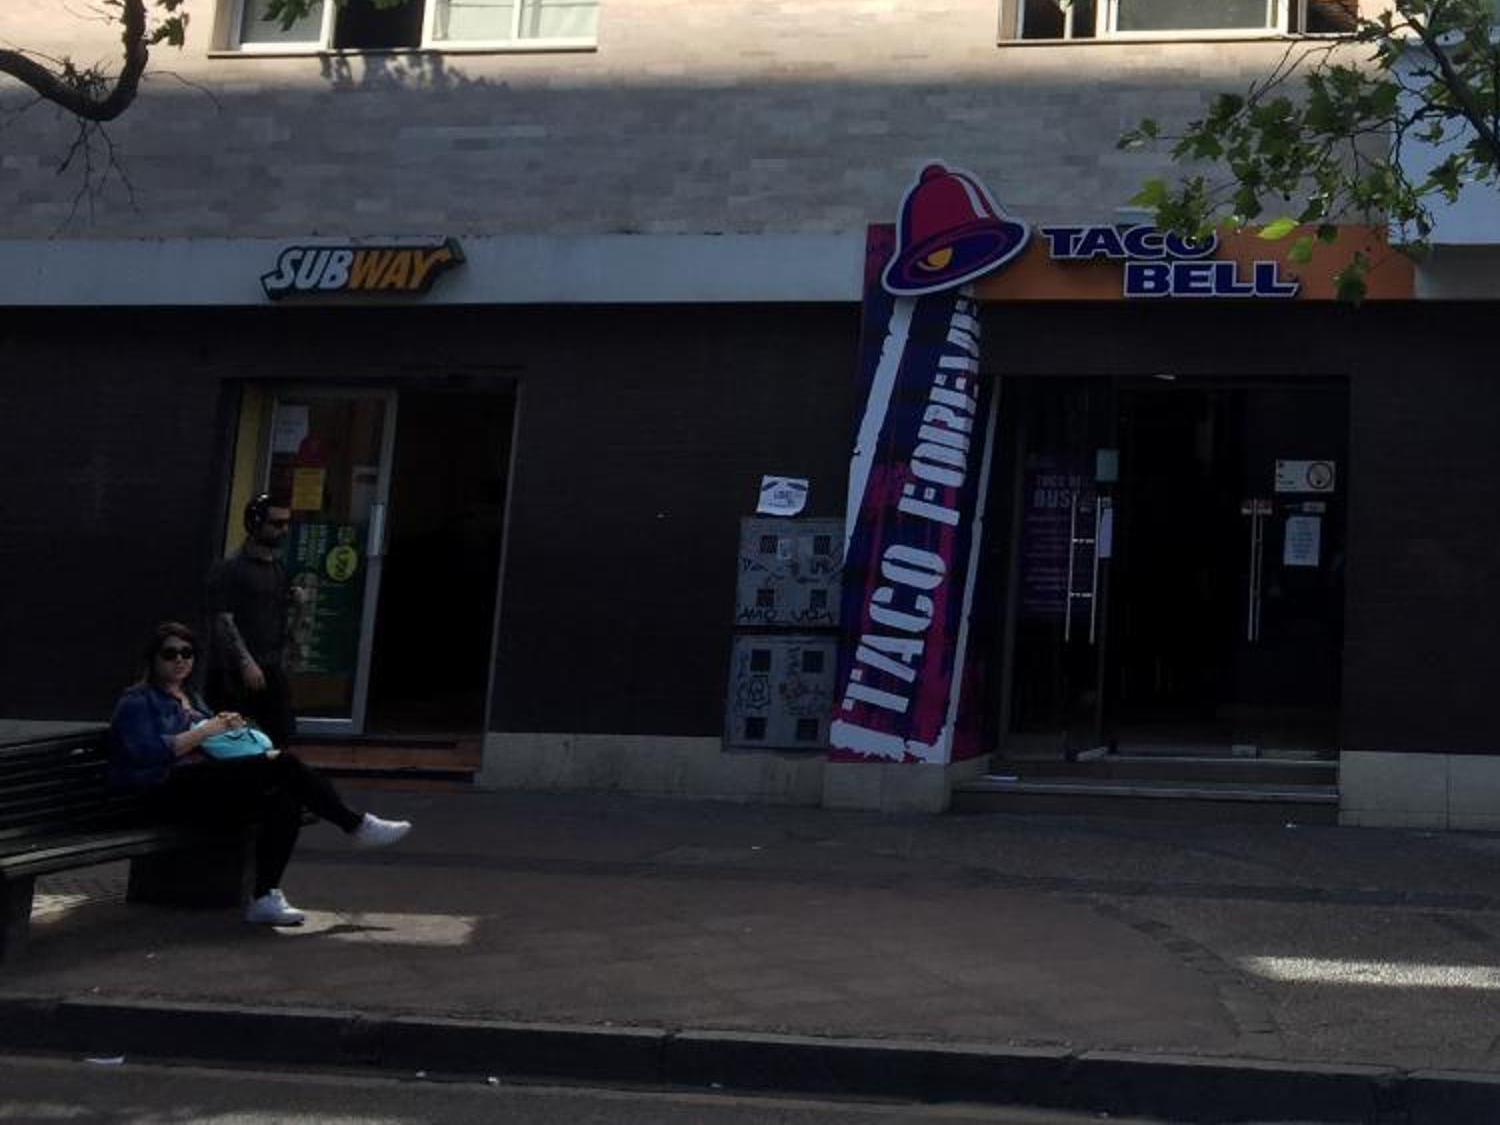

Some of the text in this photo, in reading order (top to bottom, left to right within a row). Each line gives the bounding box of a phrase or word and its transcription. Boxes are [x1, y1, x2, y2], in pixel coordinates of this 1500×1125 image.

[1039, 225, 1218, 260] TACO
[263, 246, 451, 291] SUBWAY
[1124, 261, 1299, 298] BELL
[842, 286, 985, 715] TACO FOREVE
